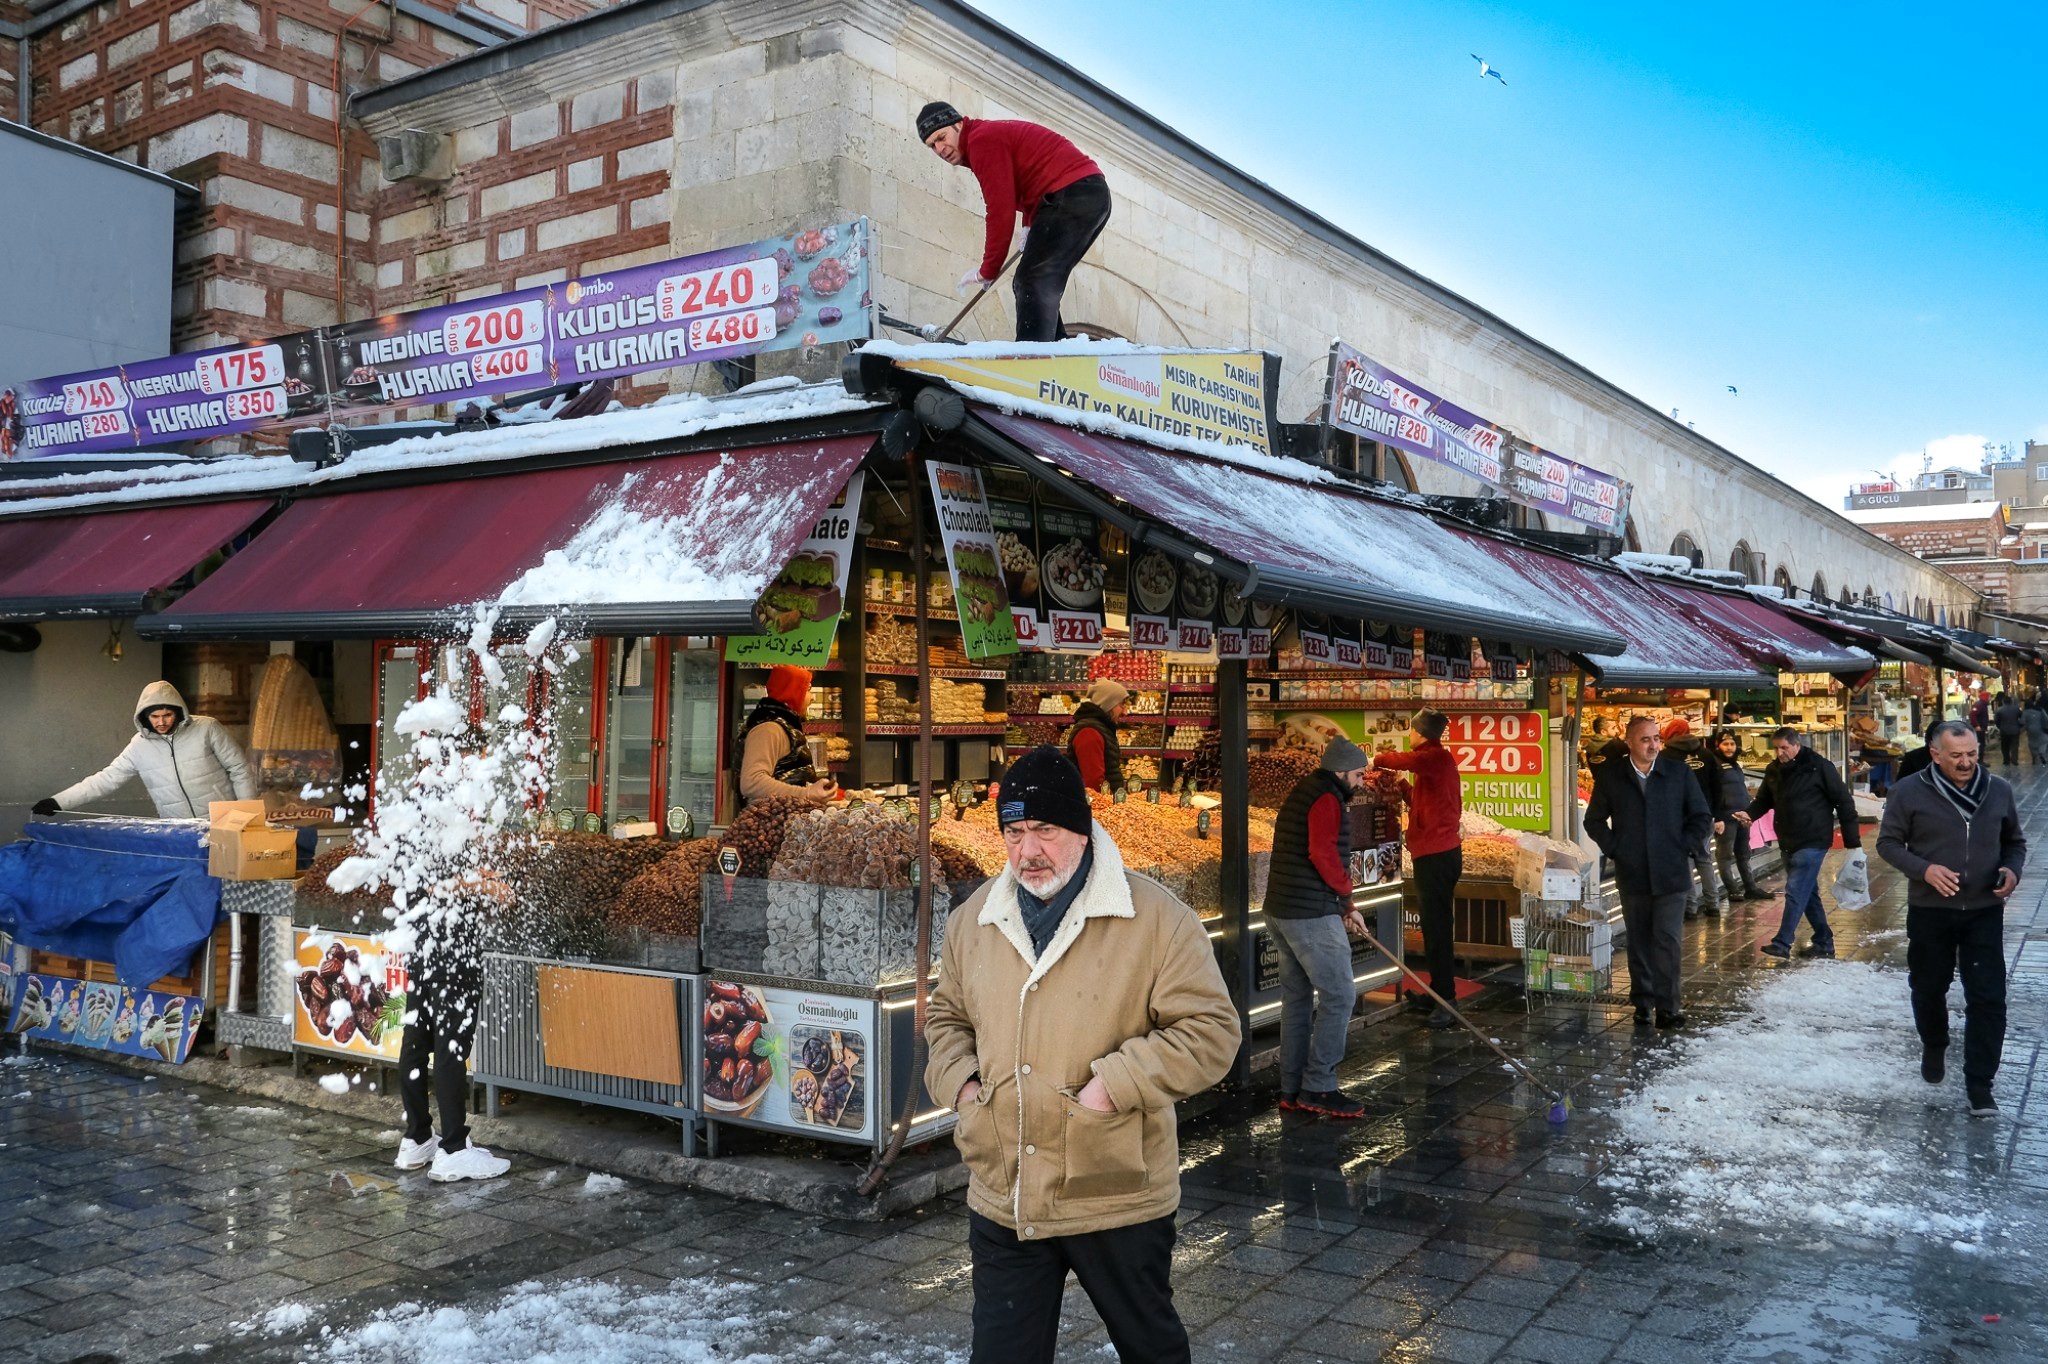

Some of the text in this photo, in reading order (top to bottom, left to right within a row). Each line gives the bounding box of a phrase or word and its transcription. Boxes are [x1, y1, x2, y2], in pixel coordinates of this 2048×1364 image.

[566, 278, 614, 304] jumbo
[679, 271, 755, 316] 240
[556, 292, 658, 340] KUDÜS
[662, 298, 674, 321] 500
[462, 309, 525, 350] 200
[705, 312, 759, 346] 480
[360, 327, 445, 365] MEDİNE
[449, 331, 458, 354] 500
[573, 328, 688, 375] HURMA
[213, 351, 267, 390] 175
[484, 347, 530, 377] 400
[130, 370, 200, 399] MEBRUM
[376, 360, 474, 401] HURMA
[1099, 365, 1161, 398] Osmanlıoğlu
[1165, 364, 1262, 411] MISIR ÇARŞISI'NDA
[1223, 362, 1260, 389] TARİHİ
[22, 393, 65, 417] KUDÜS
[75, 382, 117, 410] 140
[238, 390, 275, 415] 350
[146, 400, 228, 434] HURMA
[1038, 379, 1091, 411] FİYAT
[1195, 425, 1223, 441] TEK
[1171, 391, 1266, 438] KURUYEMİŞTE
[1339, 396, 1398, 438] HURMA
[26, 419, 85, 449] HURMA
[91, 414, 120, 434] 280
[1405, 419, 1428, 443] 280
[1445, 438, 1480, 474] HURMA
[1514, 452, 1543, 474] MEDİNE
[1546, 460, 1565, 483] 200
[1517, 475, 1547, 500] HURMA
[1598, 483, 1615, 506] 240
[1868, 494, 1900, 504] GÜÇLÜ
[941, 504, 992, 534] Chocolate
[1571, 500, 1598, 522] HURMA
[1061, 620, 1095, 640] 220
[1139, 623, 1164, 642] 240
[1185, 628, 1208, 645] 270
[1223, 635, 1239, 652] 250
[1252, 636, 1268, 652] 250
[1308, 638, 1326, 655] 230
[1341, 645, 1359, 662] 250
[1458, 715, 1520, 741] 120
[1457, 746, 1522, 773] 240
[1474, 781, 1541, 800] FISTIKLI
[1462, 801, 1544, 821] AVRULMUŞ
[798, 1002, 859, 1021] Osmanlıoğlu
